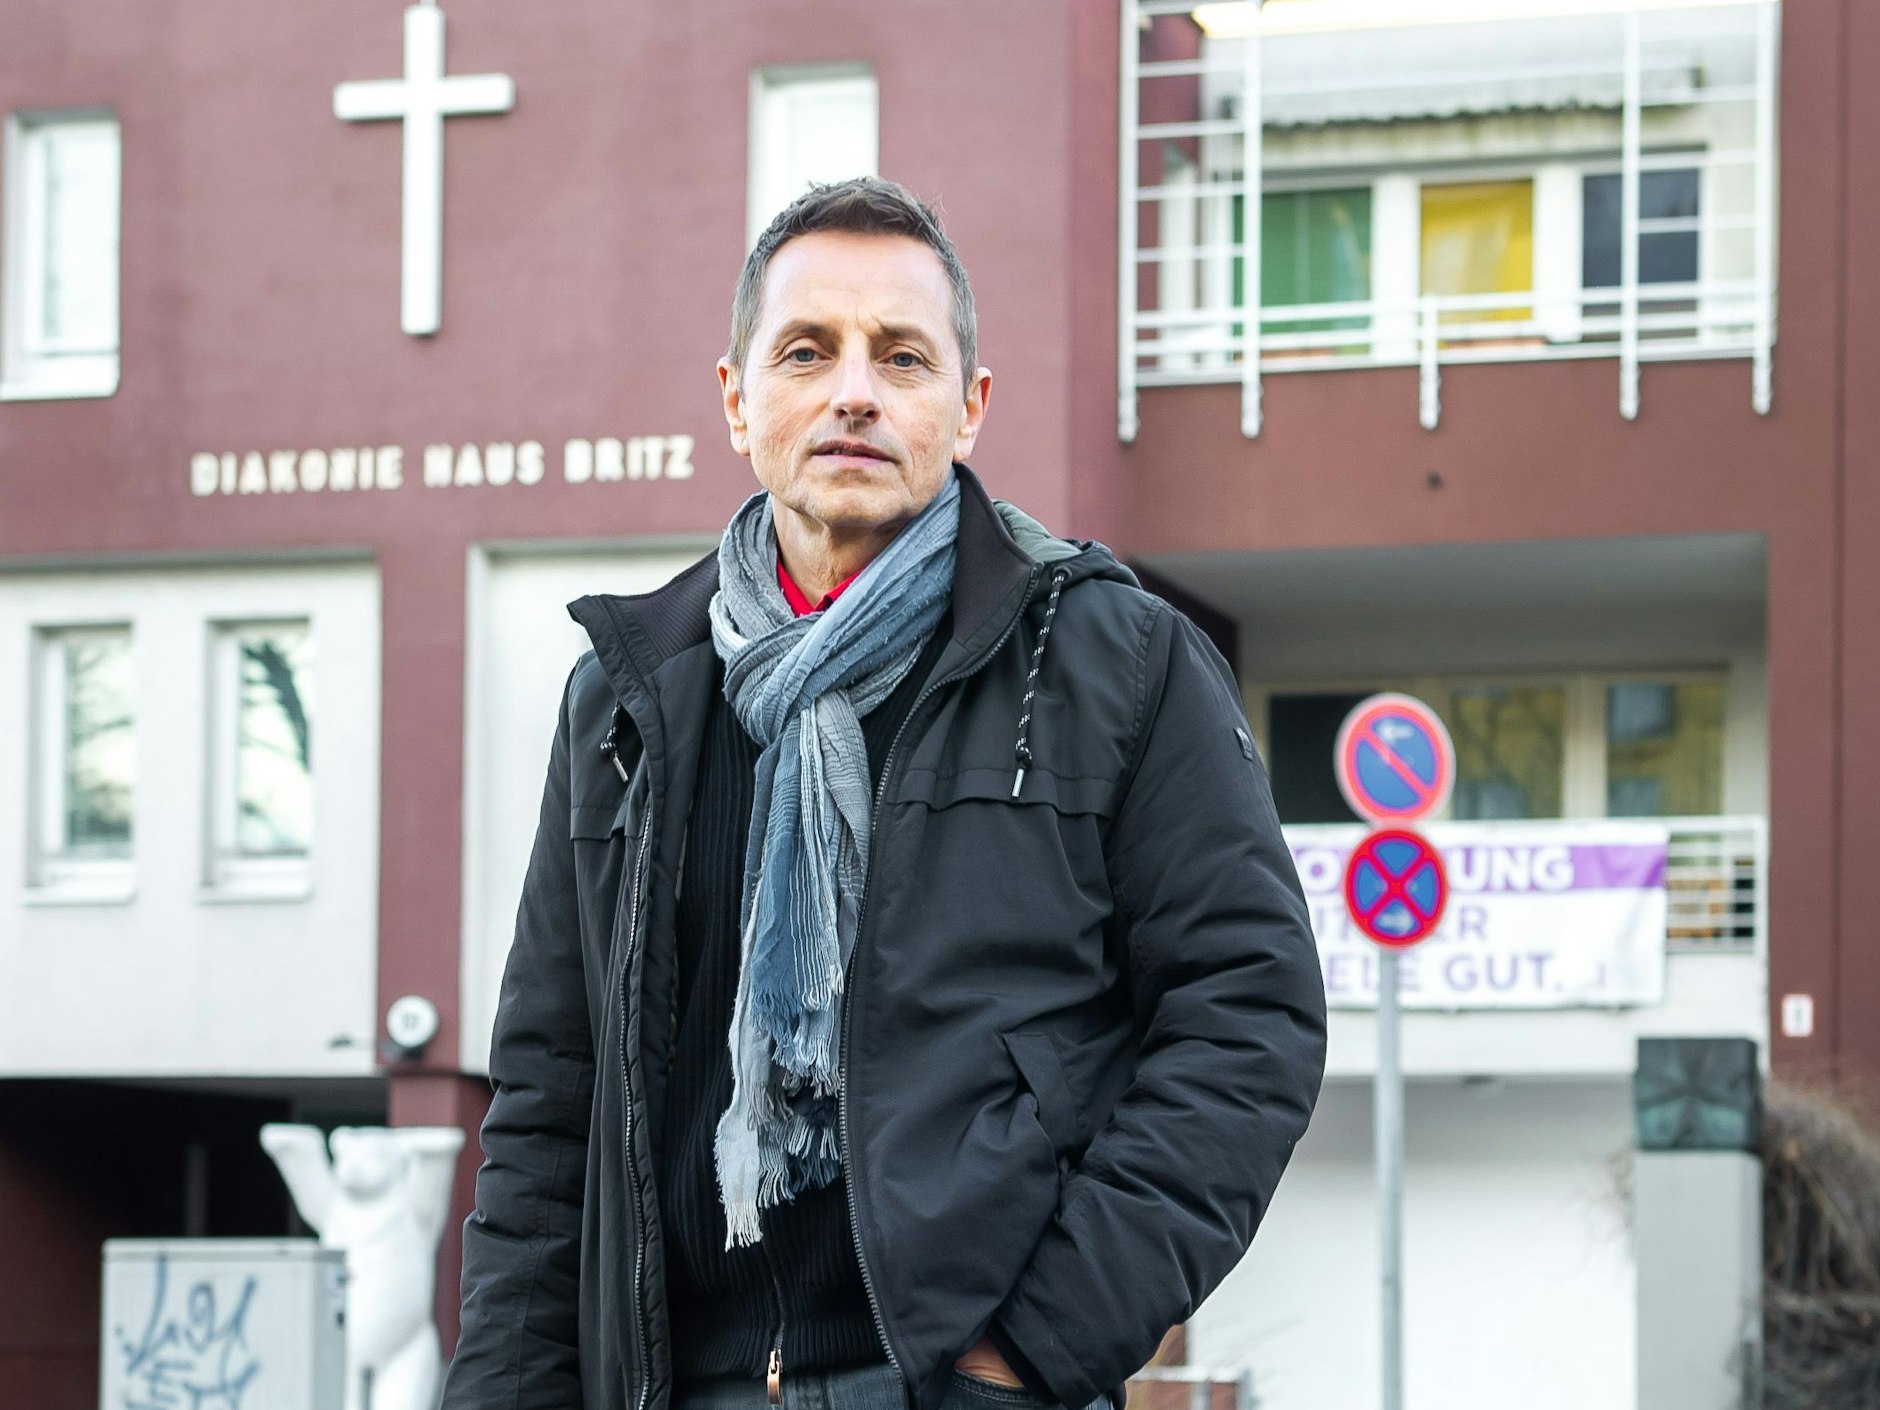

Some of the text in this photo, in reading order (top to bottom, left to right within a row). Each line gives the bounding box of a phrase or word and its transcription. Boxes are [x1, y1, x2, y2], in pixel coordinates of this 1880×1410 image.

[190, 434, 695, 496] DIAKONIE HAUS BRITZ
[1443, 953, 1564, 992] GUT.
